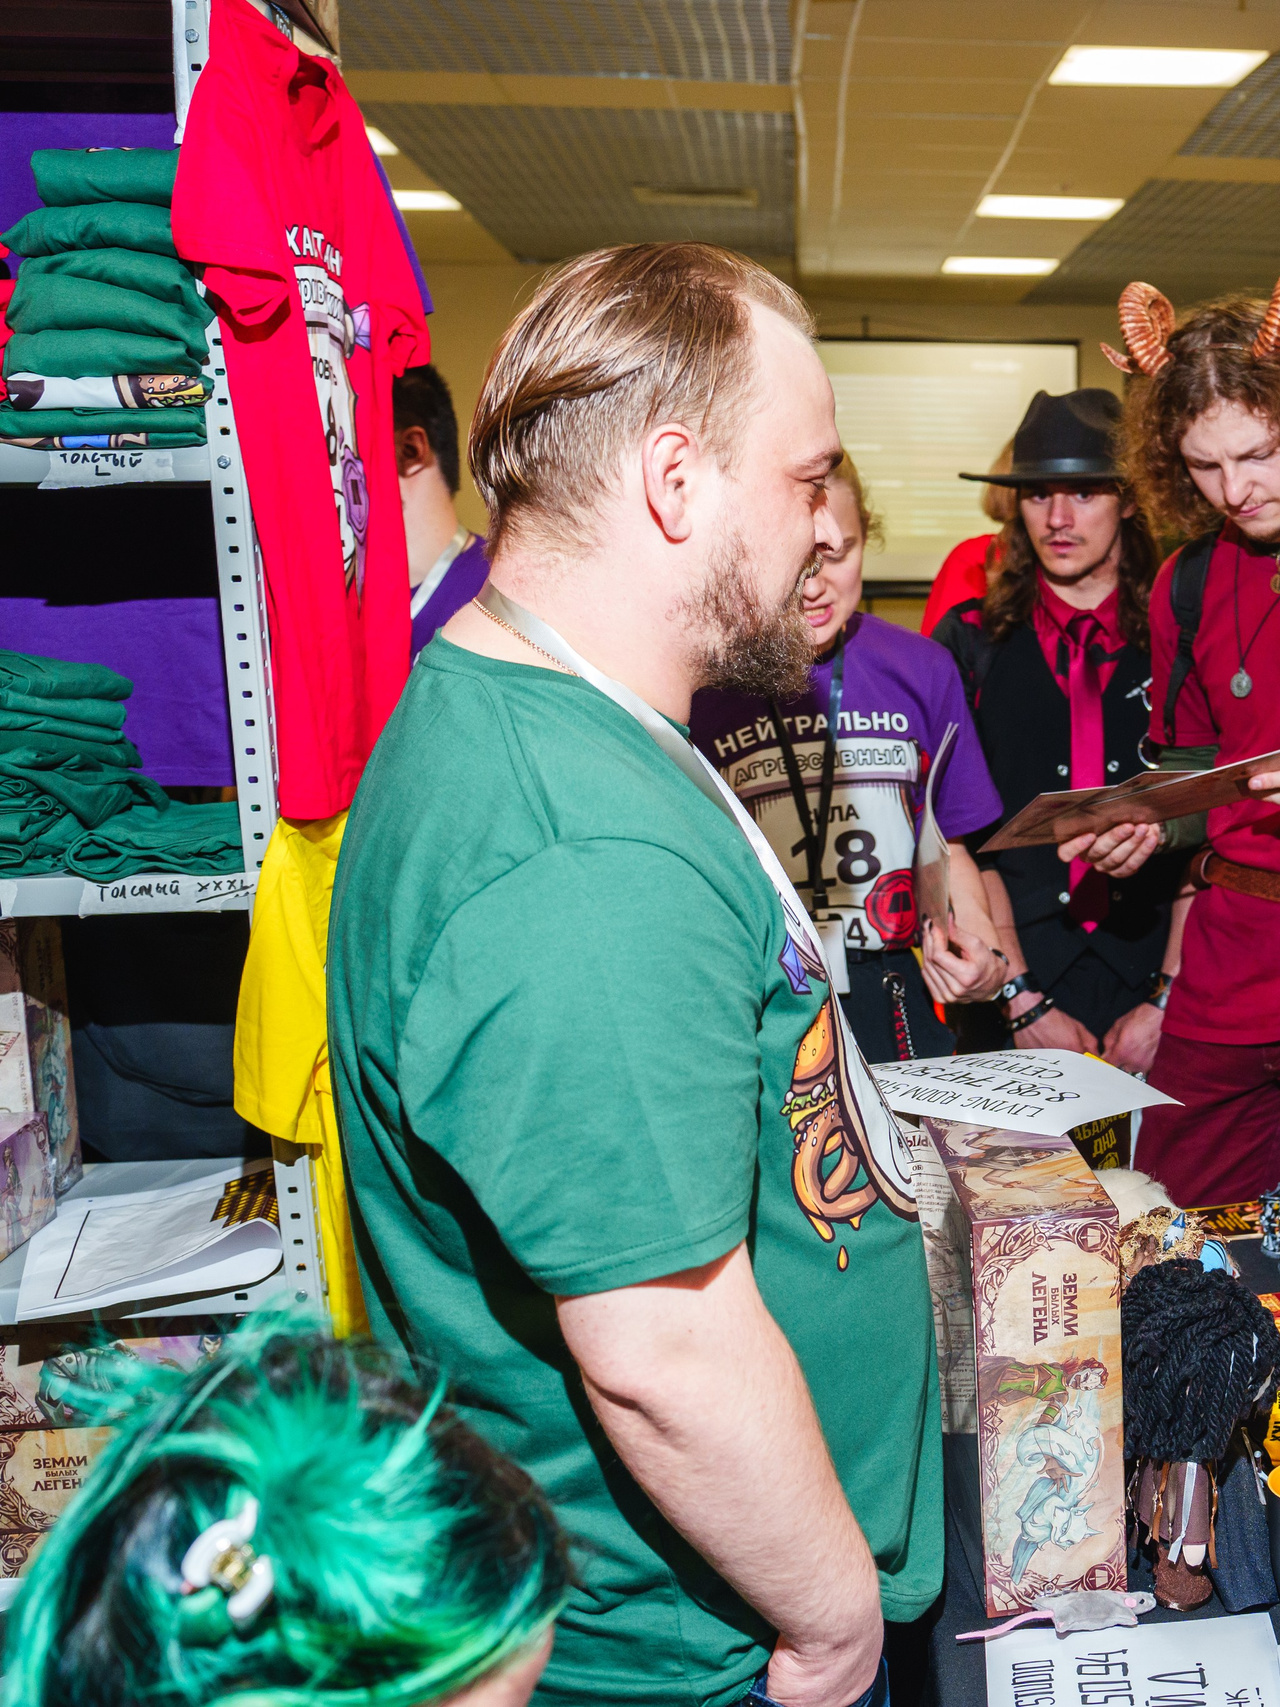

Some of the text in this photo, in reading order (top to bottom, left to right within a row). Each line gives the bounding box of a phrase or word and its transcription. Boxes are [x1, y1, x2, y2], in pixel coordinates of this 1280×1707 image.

[95, 465, 112, 476] L
[898, 1085, 963, 1106] ROOM
[959, 1096, 1045, 1118] LIVING
[1093, 1127, 1118, 1158] ДНД
[1031, 1270, 1049, 1347] ЛЕГЕНД
[1050, 1287, 1060, 1326] БЫЛЫХ
[1062, 1273, 1079, 1337] ЗЕМЛИ
[32, 1455, 88, 1469] ЗЕМЛИ
[45, 1469, 78, 1478] БЫЛЫХ
[31, 1478, 84, 1492] ЛЕГЕН
[1011, 1659, 1055, 1707] STUDIO
